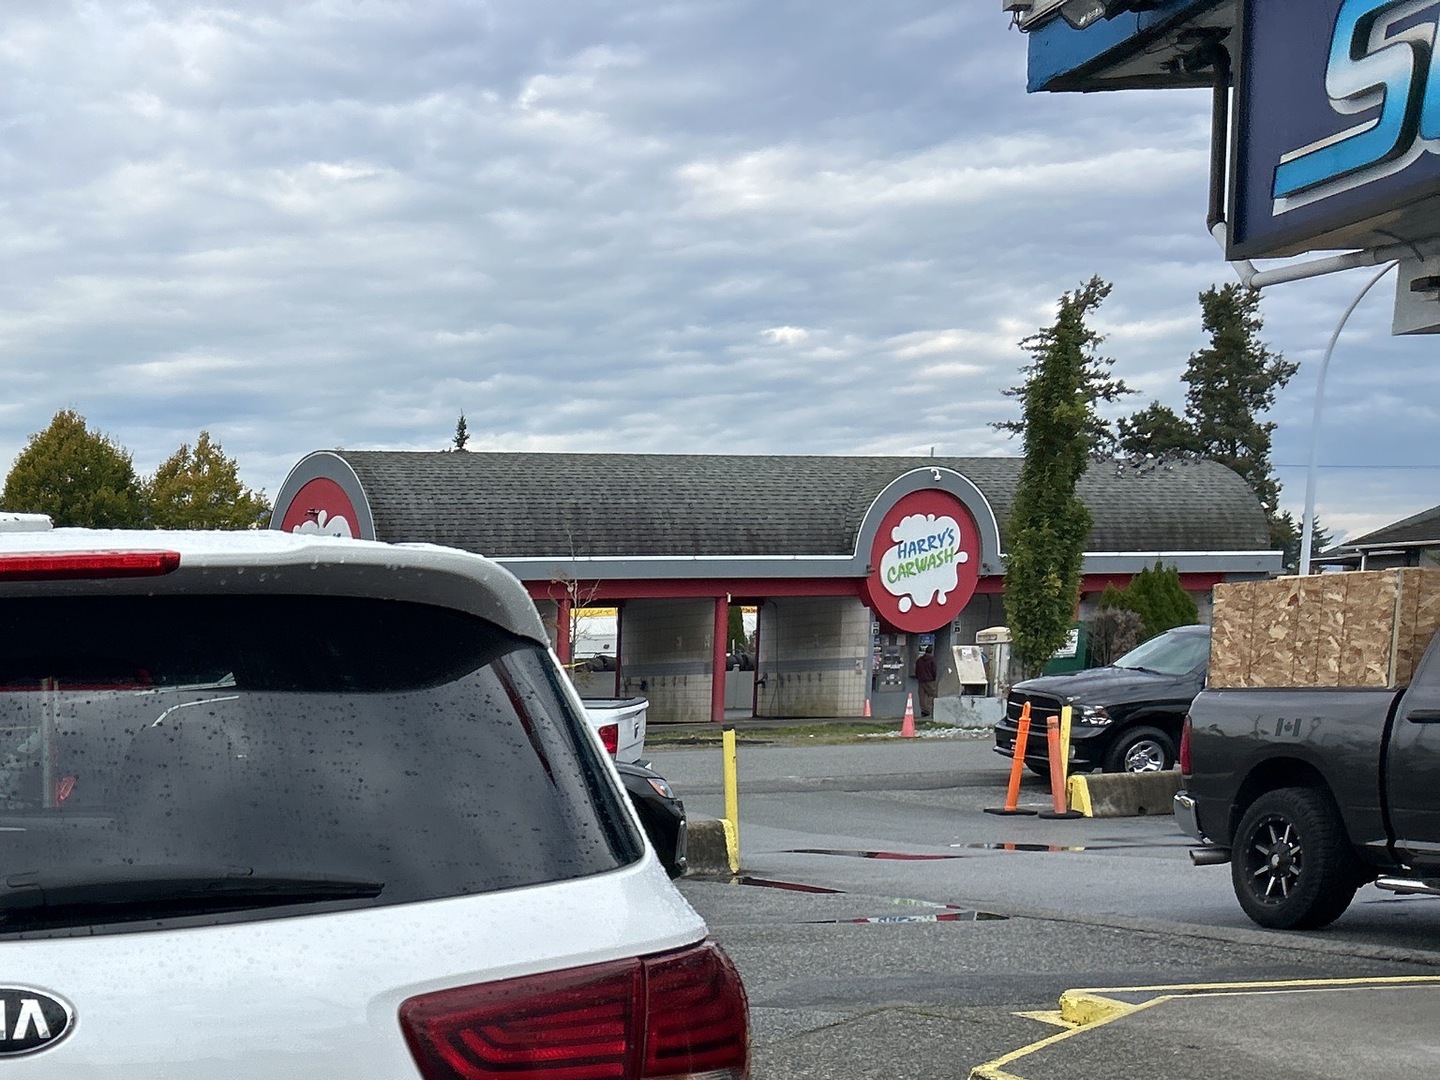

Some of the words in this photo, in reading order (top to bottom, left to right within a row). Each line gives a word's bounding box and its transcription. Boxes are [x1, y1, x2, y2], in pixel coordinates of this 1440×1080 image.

[1273, 0, 1440, 206] S
[897, 527, 955, 559] HARRY'S
[887, 547, 955, 584] CARWASH
